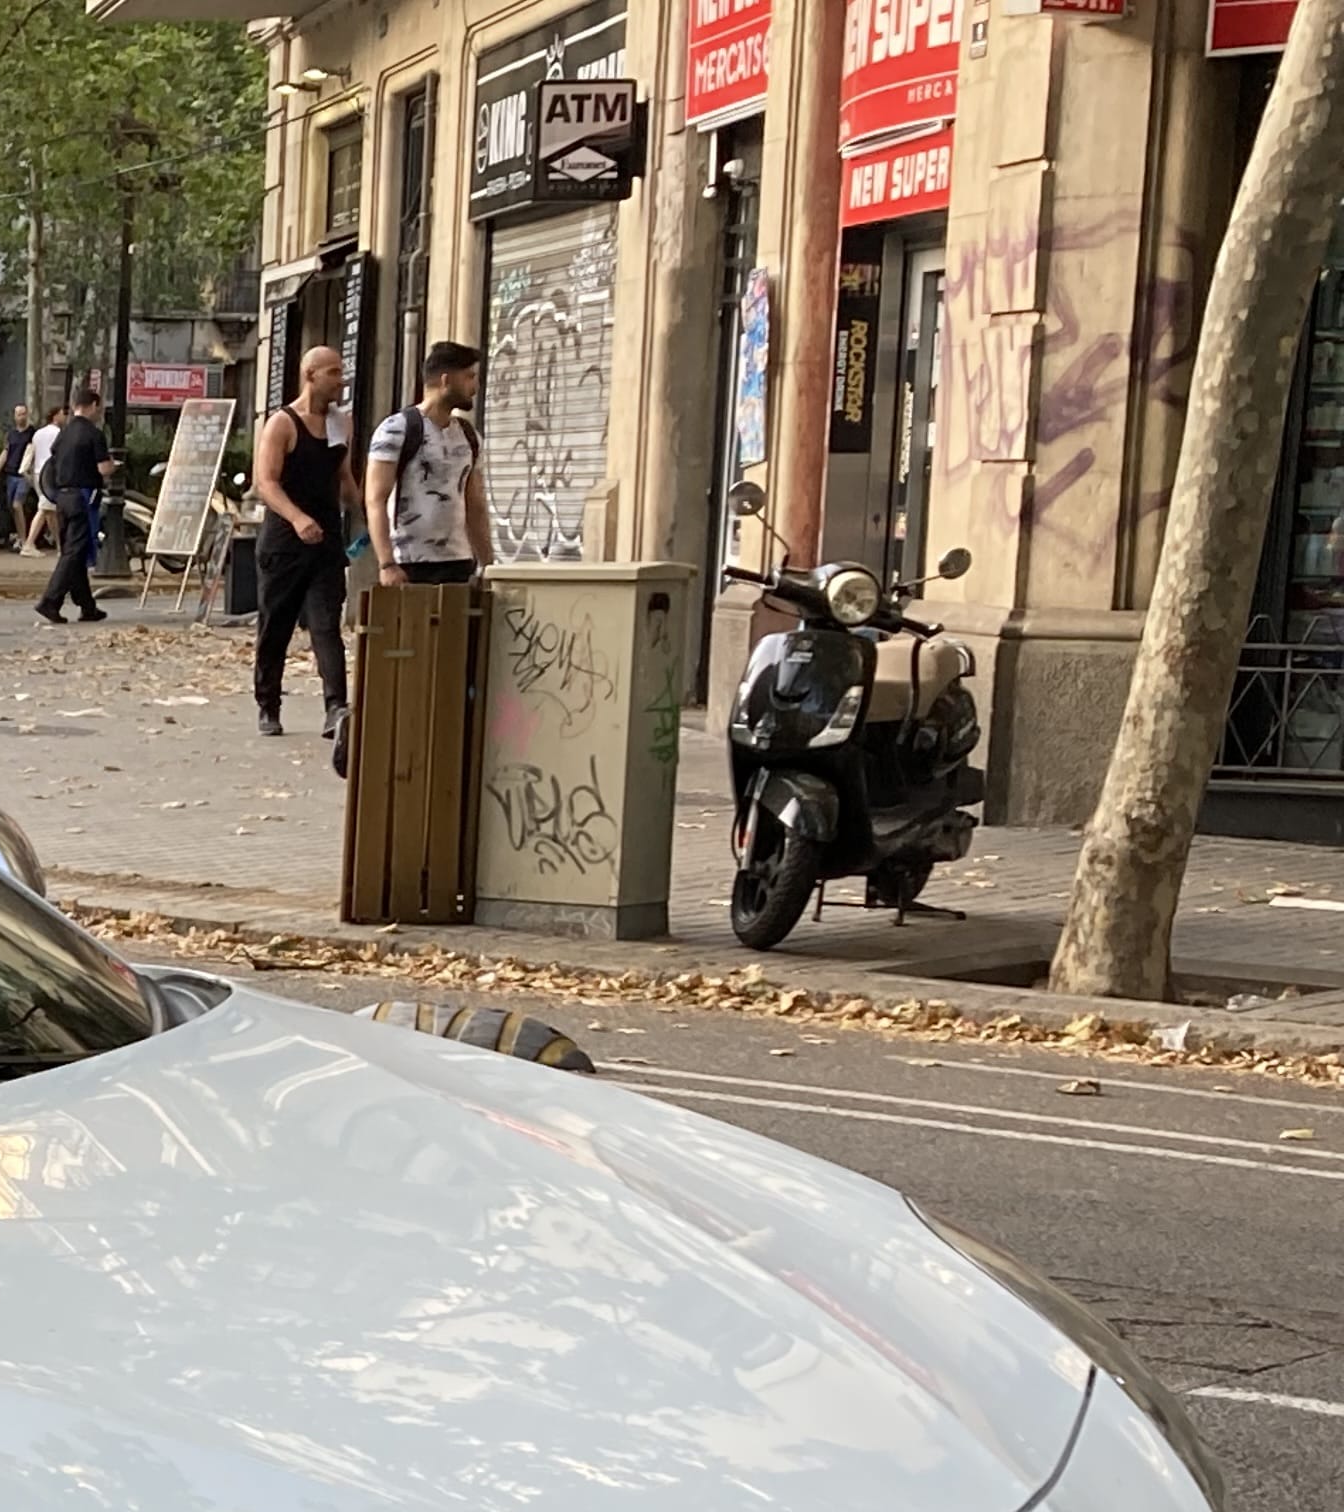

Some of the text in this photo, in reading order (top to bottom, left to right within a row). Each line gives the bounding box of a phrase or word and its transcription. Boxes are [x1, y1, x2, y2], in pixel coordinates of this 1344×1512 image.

[545, 93, 628, 124] ATM
[849, 146, 950, 210] NEW SUPER
[844, 319, 869, 423] ROCKSTAR
